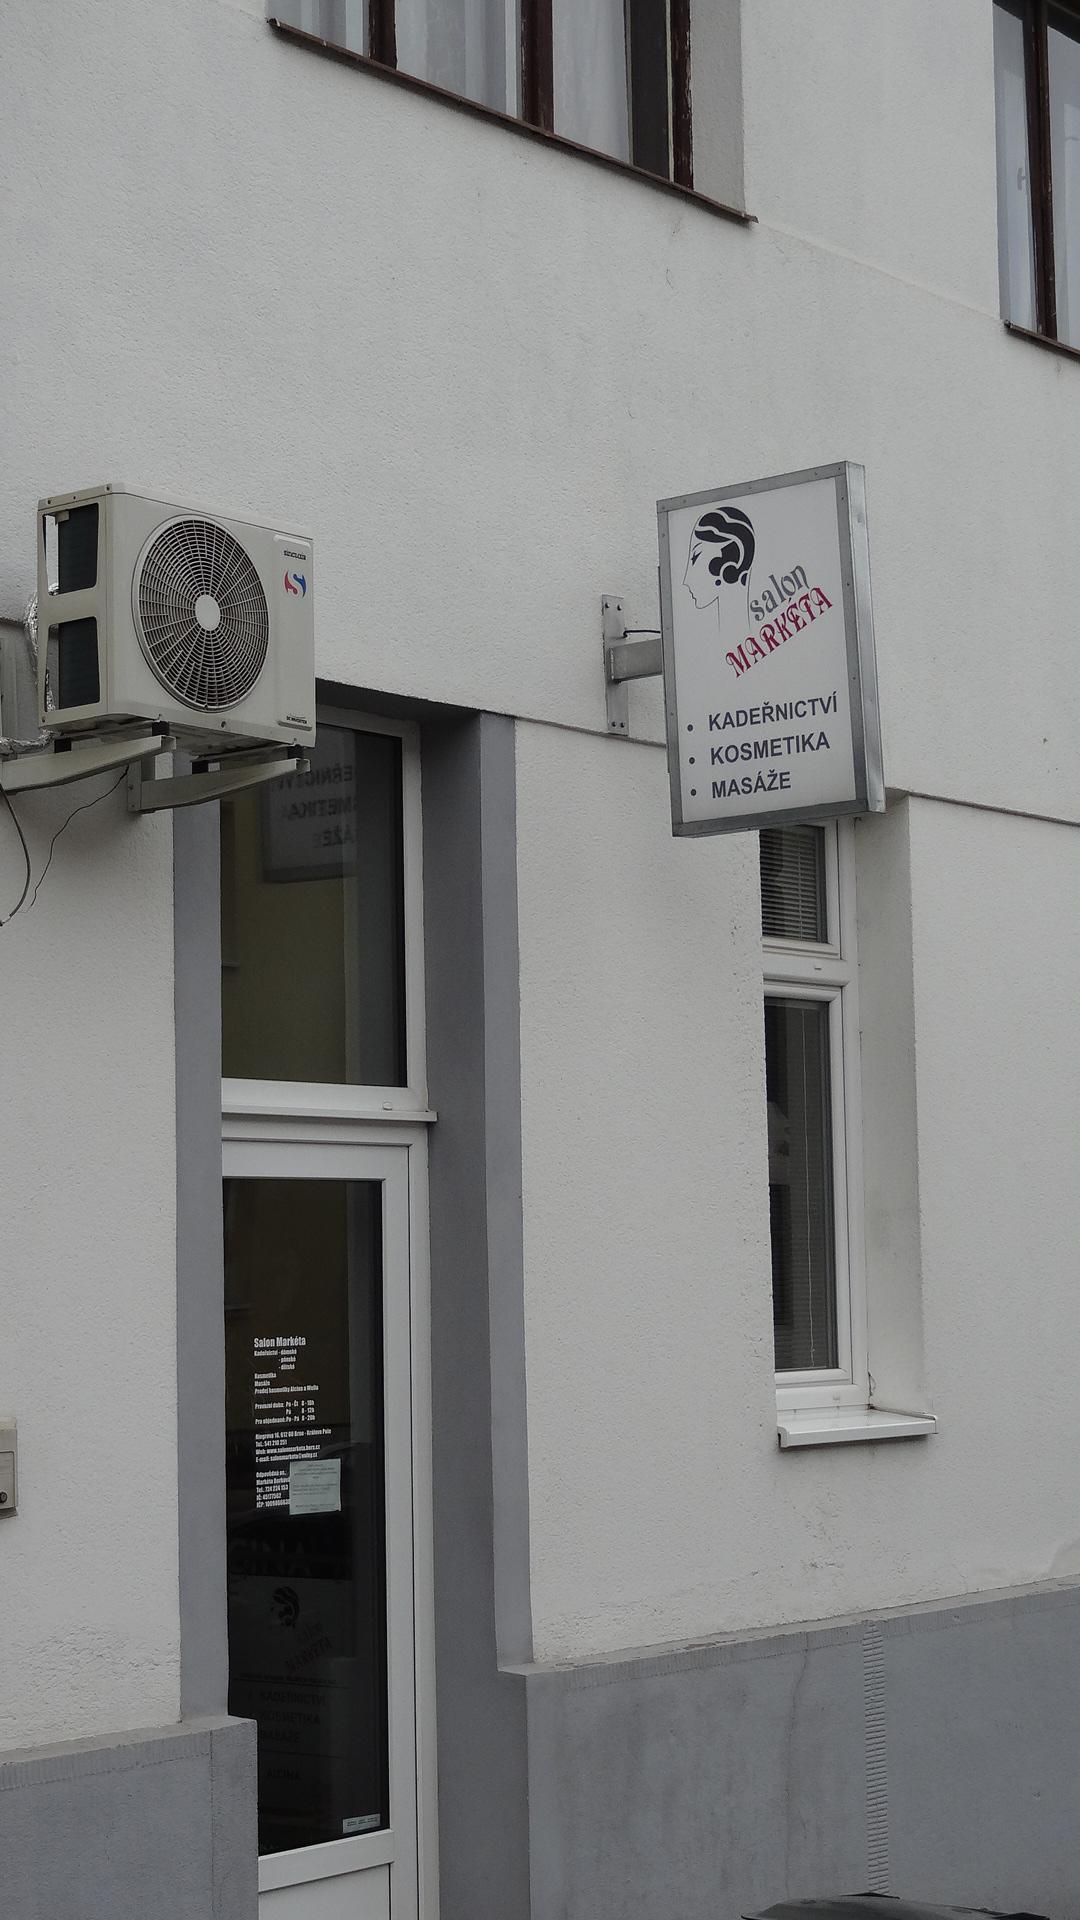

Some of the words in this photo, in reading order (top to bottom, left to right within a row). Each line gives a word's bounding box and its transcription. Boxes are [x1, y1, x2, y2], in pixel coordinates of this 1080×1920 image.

[750, 565, 810, 621] salon
[725, 587, 833, 678] MARKÉTA
[709, 691, 837, 731] KADEŘNICTVÍ
[711, 732, 830, 765] KOSMETIKA
[712, 769, 791, 798] MASÁŽE
[254, 1337, 275, 1348] Salon
[276, 1336, 306, 1347] Markéta
